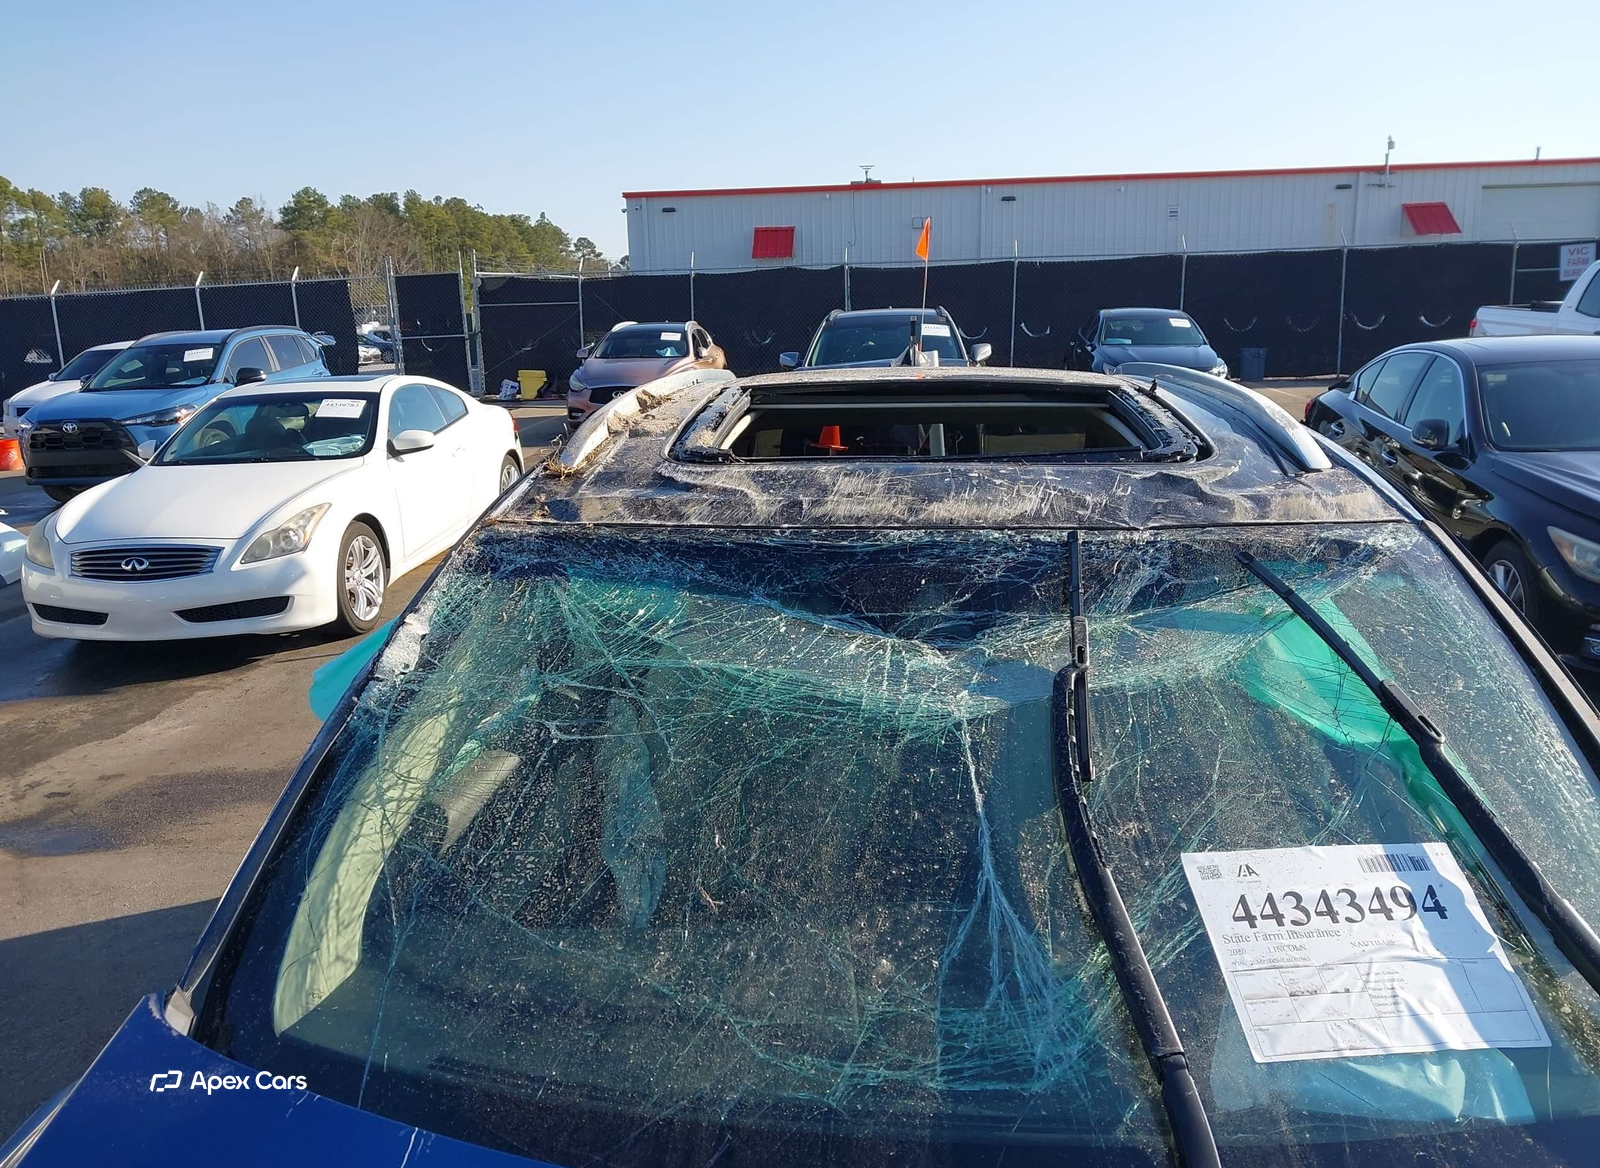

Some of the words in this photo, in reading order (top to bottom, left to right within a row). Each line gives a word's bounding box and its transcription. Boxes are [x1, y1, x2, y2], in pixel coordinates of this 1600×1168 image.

[1568, 246, 1590, 256] VIC
[1567, 257, 1590, 267] FARM
[1232, 884, 1449, 929] 44343494
[1222, 933, 1252, 945] State
[1253, 930, 1285, 942] Farm
[1286, 928, 1342, 941] Insurance
[1229, 948, 1247, 957] 2020
[1267, 944, 1308, 954] LINCOLN
[1349, 938, 1396, 949] NAUTILUS
